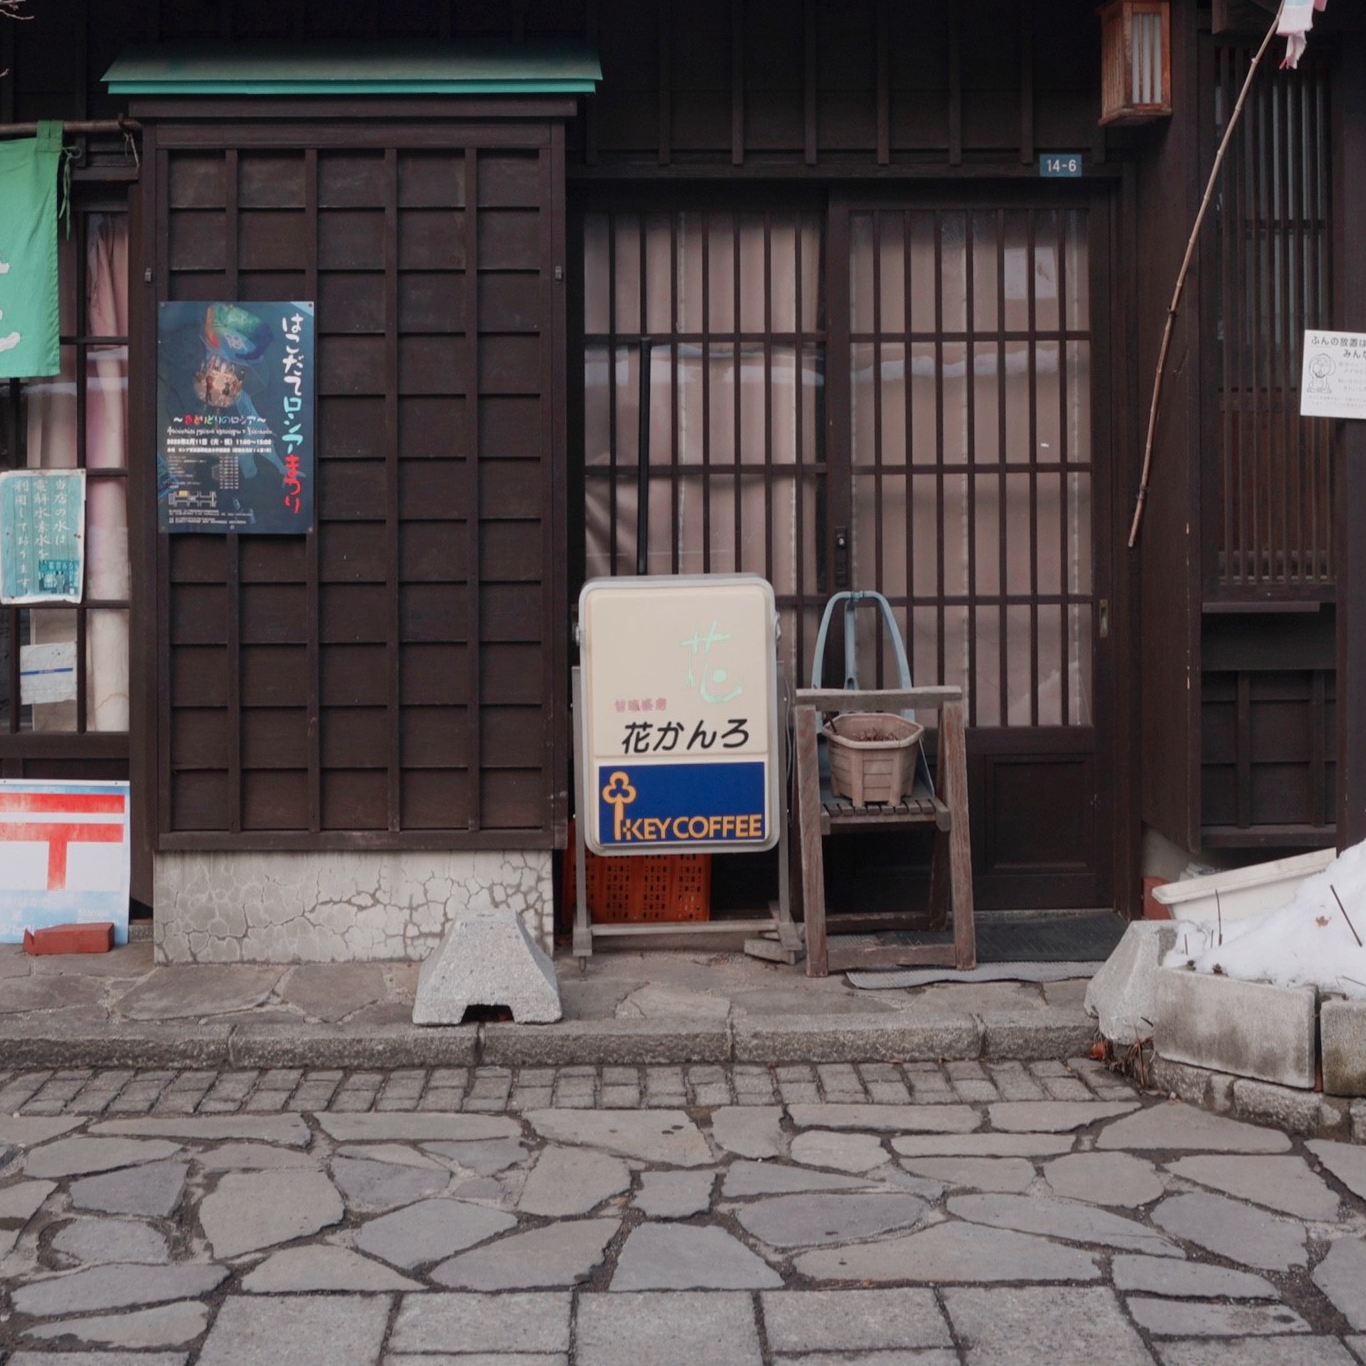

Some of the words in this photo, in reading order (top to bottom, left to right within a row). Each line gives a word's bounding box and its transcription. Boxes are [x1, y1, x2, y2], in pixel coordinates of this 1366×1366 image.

[1047, 160, 1077, 172] 14-6
[281, 313, 305, 515] はこだてロシアまつり
[14, 479, 30, 588] 利用しております
[53, 478, 70, 546] 当店の水は
[621, 717, 750, 755] 花かんろ
[621, 818, 672, 841] KEY
[672, 814, 763, 840] COFFEE
